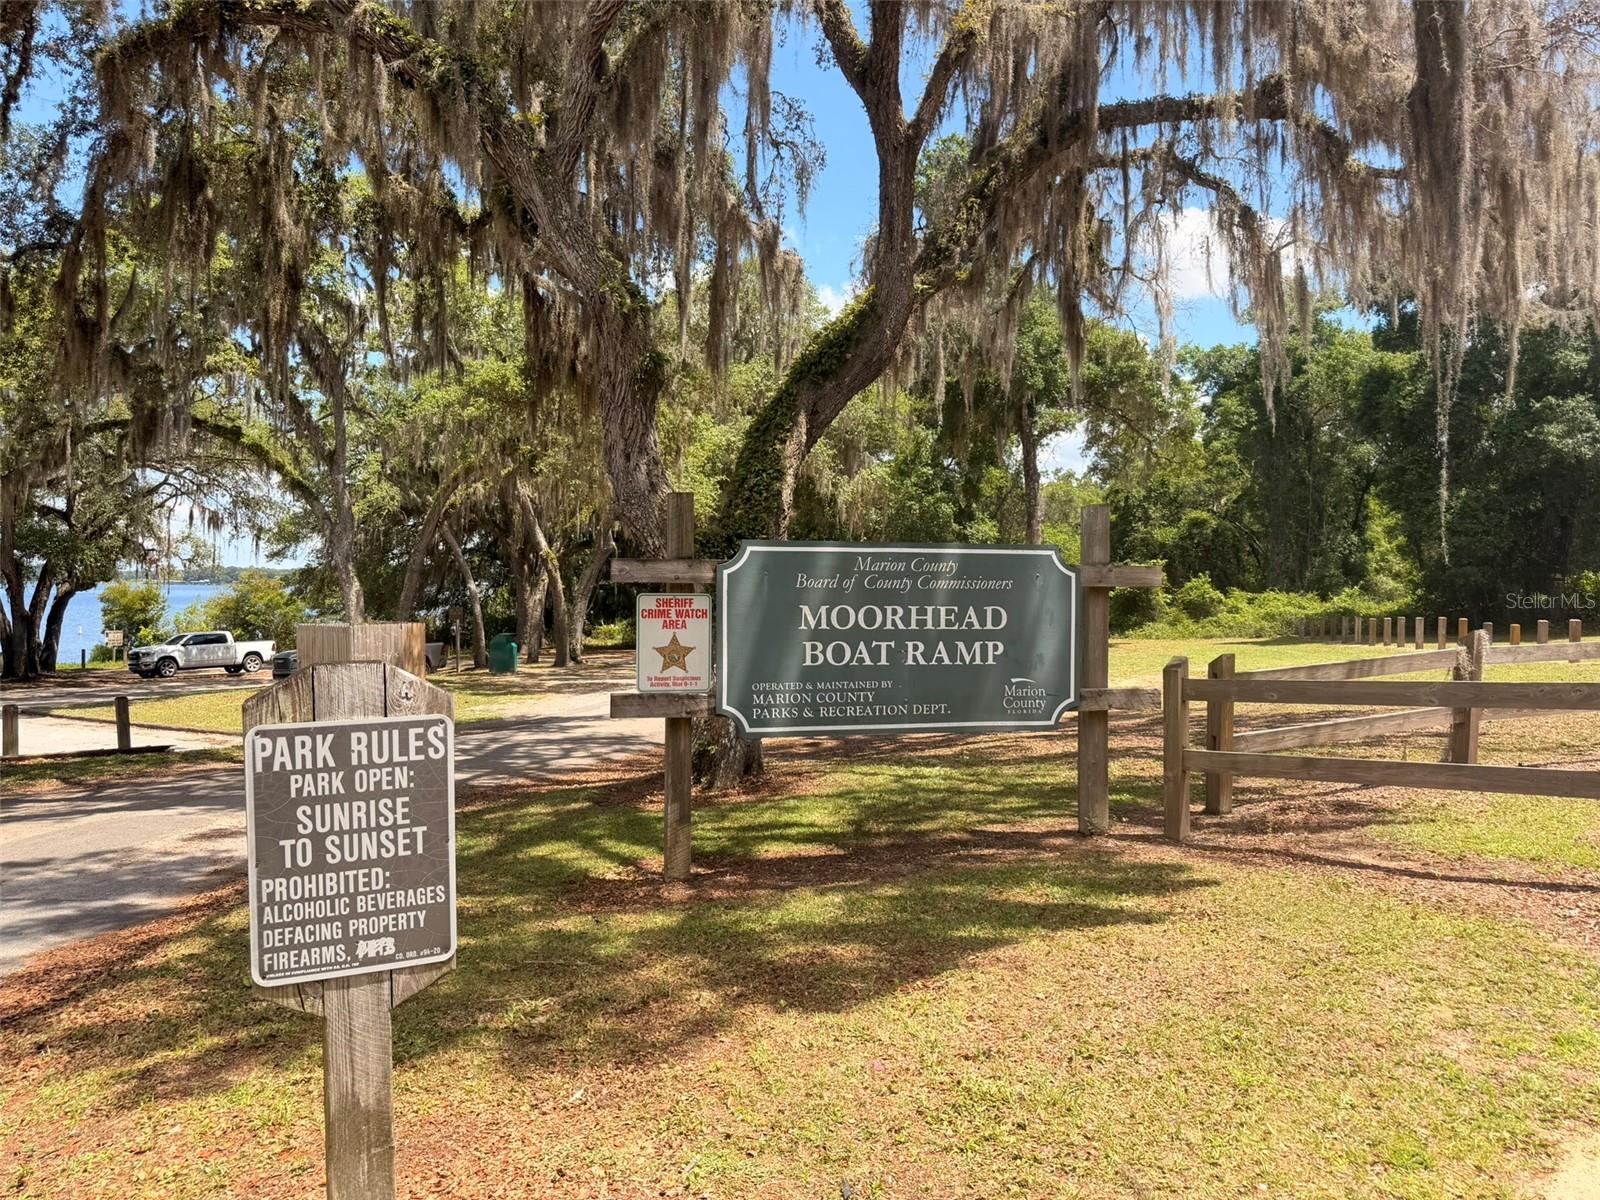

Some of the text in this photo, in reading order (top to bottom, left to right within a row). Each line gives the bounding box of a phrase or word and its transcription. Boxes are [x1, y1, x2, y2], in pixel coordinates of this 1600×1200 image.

[853, 556, 959, 577] Marion County
[795, 573, 1014, 594] Board of County Commissioners
[641, 609, 708, 619] CRIME WATCH
[655, 598, 694, 608] SHERIFF
[662, 620, 687, 630] AREA
[798, 604, 1008, 631] MOORHEAD
[802, 640, 1005, 666] BOAT RAMP
[752, 680, 893, 691] OPERATED & MAINTAINED BY
[1004, 684, 1046, 697] Marion
[752, 691, 875, 705] MARION COUNTY
[1003, 696, 1046, 710] County
[752, 703, 951, 719] PARKS & RECREATION DEPT.
[254, 725, 446, 773] PARK RULES
[290, 766, 415, 798] PARK OPEN:
[296, 796, 410, 835] SUNRISE
[279, 825, 428, 869] TO SUNSET
[261, 867, 390, 903] PROHIBITED:
[263, 885, 446, 925] ALCOHOLIC BEVERAGES
[263, 910, 427, 949] DEFACING PROPERTY
[263, 944, 351, 972] FIREARMS,
